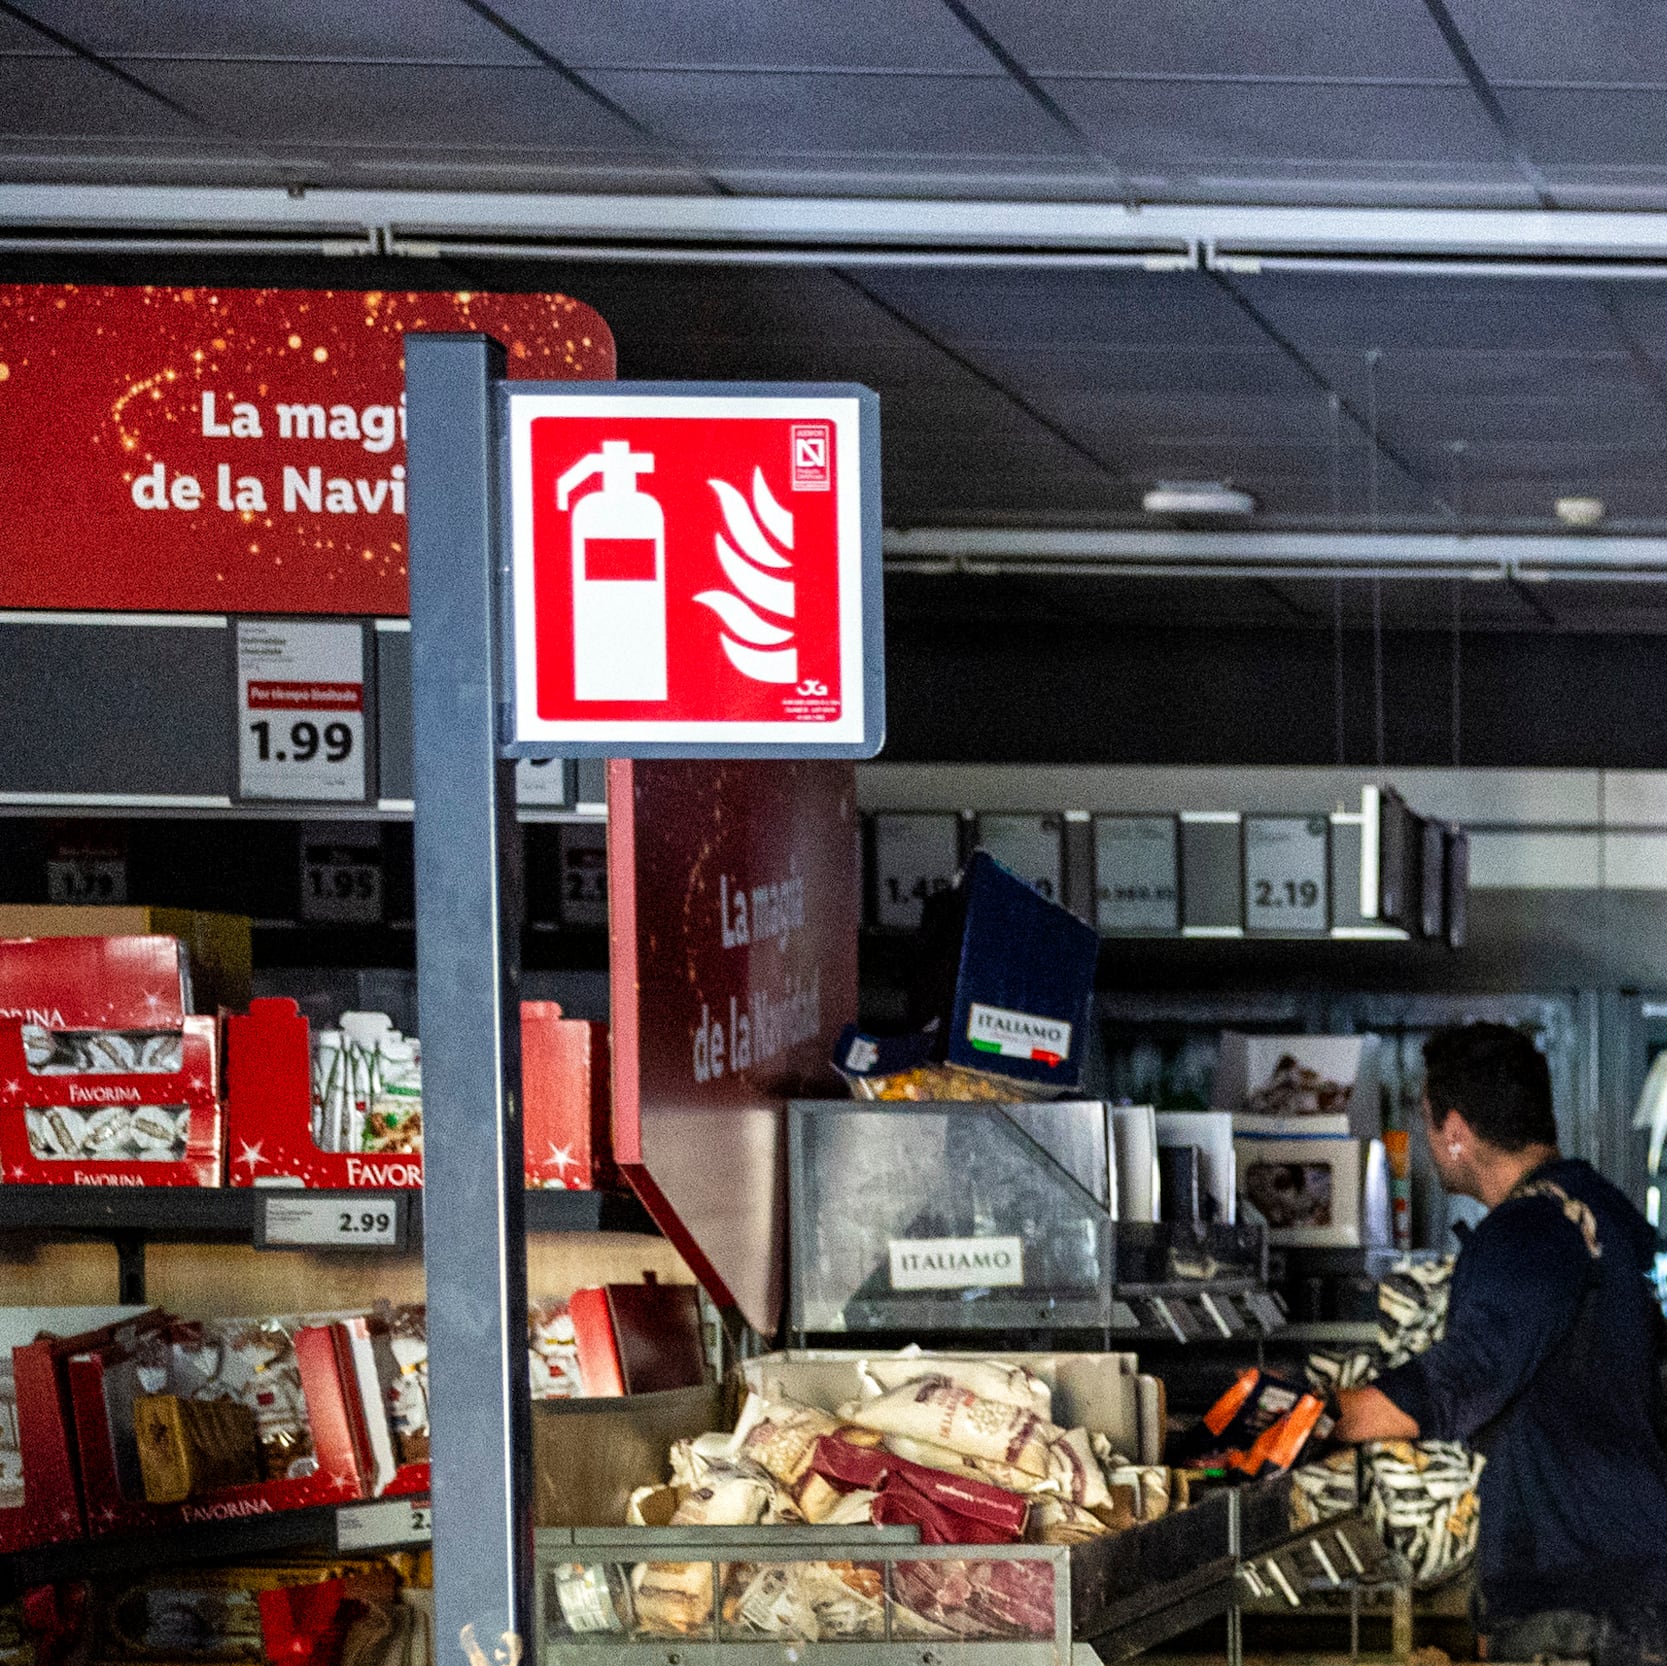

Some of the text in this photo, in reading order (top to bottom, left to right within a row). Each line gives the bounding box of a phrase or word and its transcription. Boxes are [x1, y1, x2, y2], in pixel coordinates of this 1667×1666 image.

[202, 390, 263, 438] La
[131, 462, 203, 511] de
[217, 462, 268, 512] la
[250, 720, 354, 763] 1.99
[719, 873, 750, 949] La
[1254, 882, 1320, 908] 2.19
[692, 1003, 727, 1082] de
[730, 996, 752, 1073] la
[977, 1012, 1061, 1044] ITALIAMO
[69, 1083, 140, 1104] FAVORINA
[338, 1212, 391, 1233] 2.99
[898, 1248, 1010, 1271] ITALIAMO
[181, 1499, 271, 1524] FAVORINA
